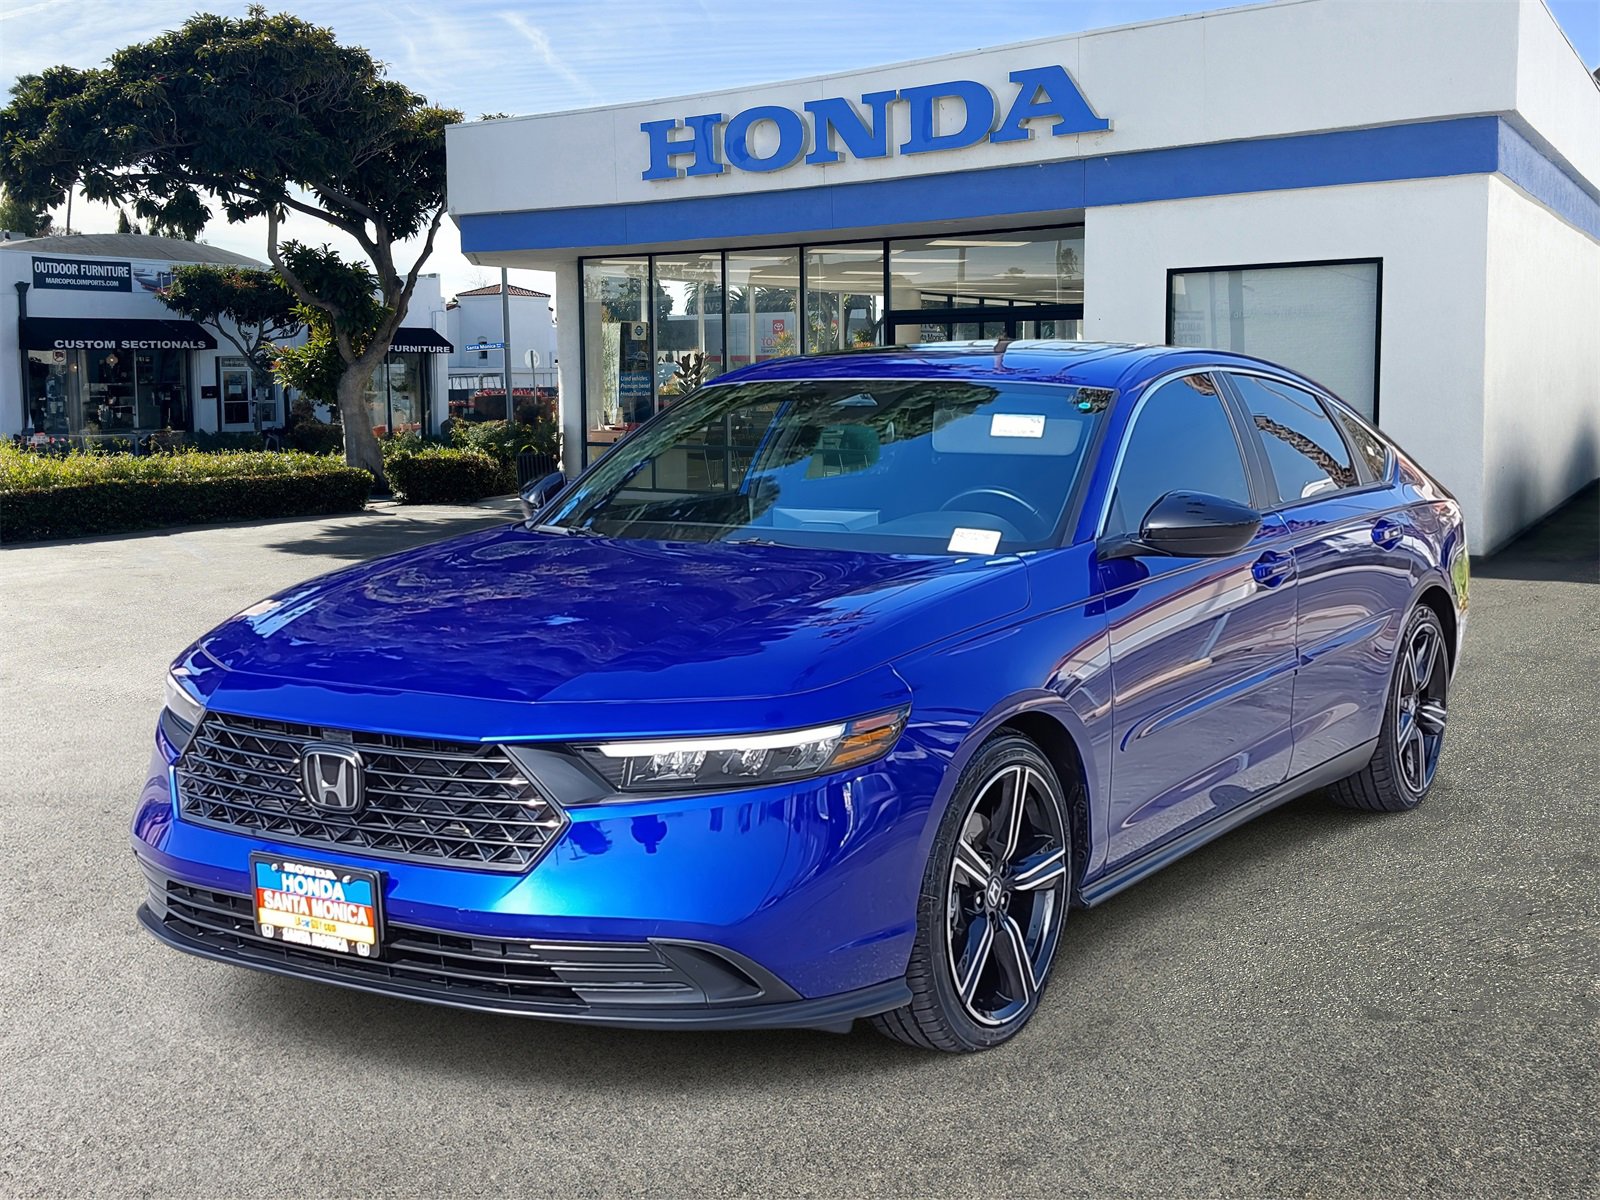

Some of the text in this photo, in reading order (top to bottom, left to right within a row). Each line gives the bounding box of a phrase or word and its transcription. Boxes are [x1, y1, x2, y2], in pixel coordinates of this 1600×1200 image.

[640, 65, 1113, 182] HONDA
[34, 261, 130, 278] OUTDOOR FURNITURE
[45, 277, 119, 287] MARCOPOLOIMPORTS.COM
[54, 339, 206, 349] CUSTOM SECTIONALS
[388, 344, 451, 353] FURNITURE
[281, 873, 345, 902] HONDA
[263, 890, 310, 915] SANTA
[310, 898, 369, 925] MONICA
